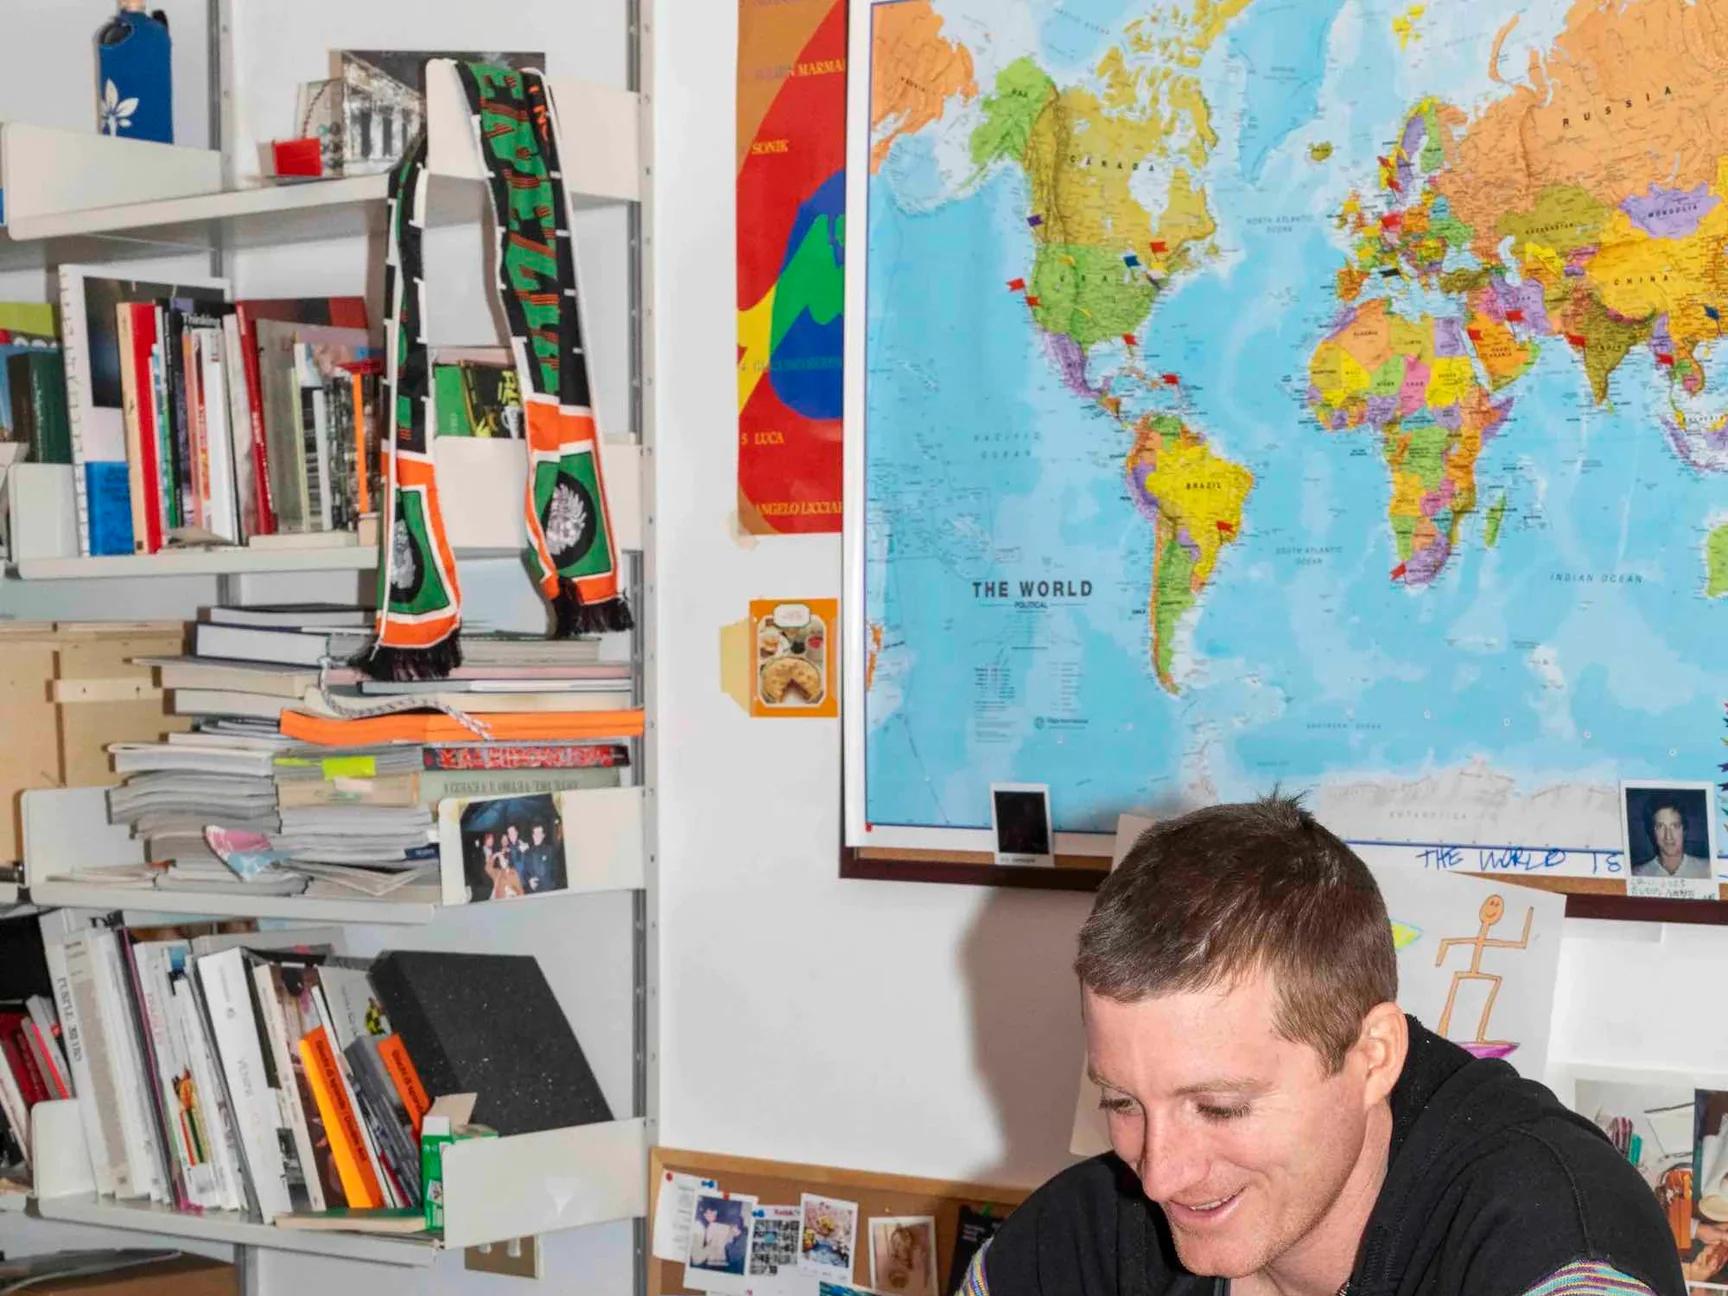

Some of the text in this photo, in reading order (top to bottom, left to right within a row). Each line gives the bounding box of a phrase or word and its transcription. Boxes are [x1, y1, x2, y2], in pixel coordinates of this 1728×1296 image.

[1562, 85, 1672, 128] RUSSIA
[1069, 154, 1154, 172] CANADA
[972, 580, 1093, 598] THE WORLD
[1415, 847, 1464, 869] THE
[1479, 847, 1567, 873] WORLD
